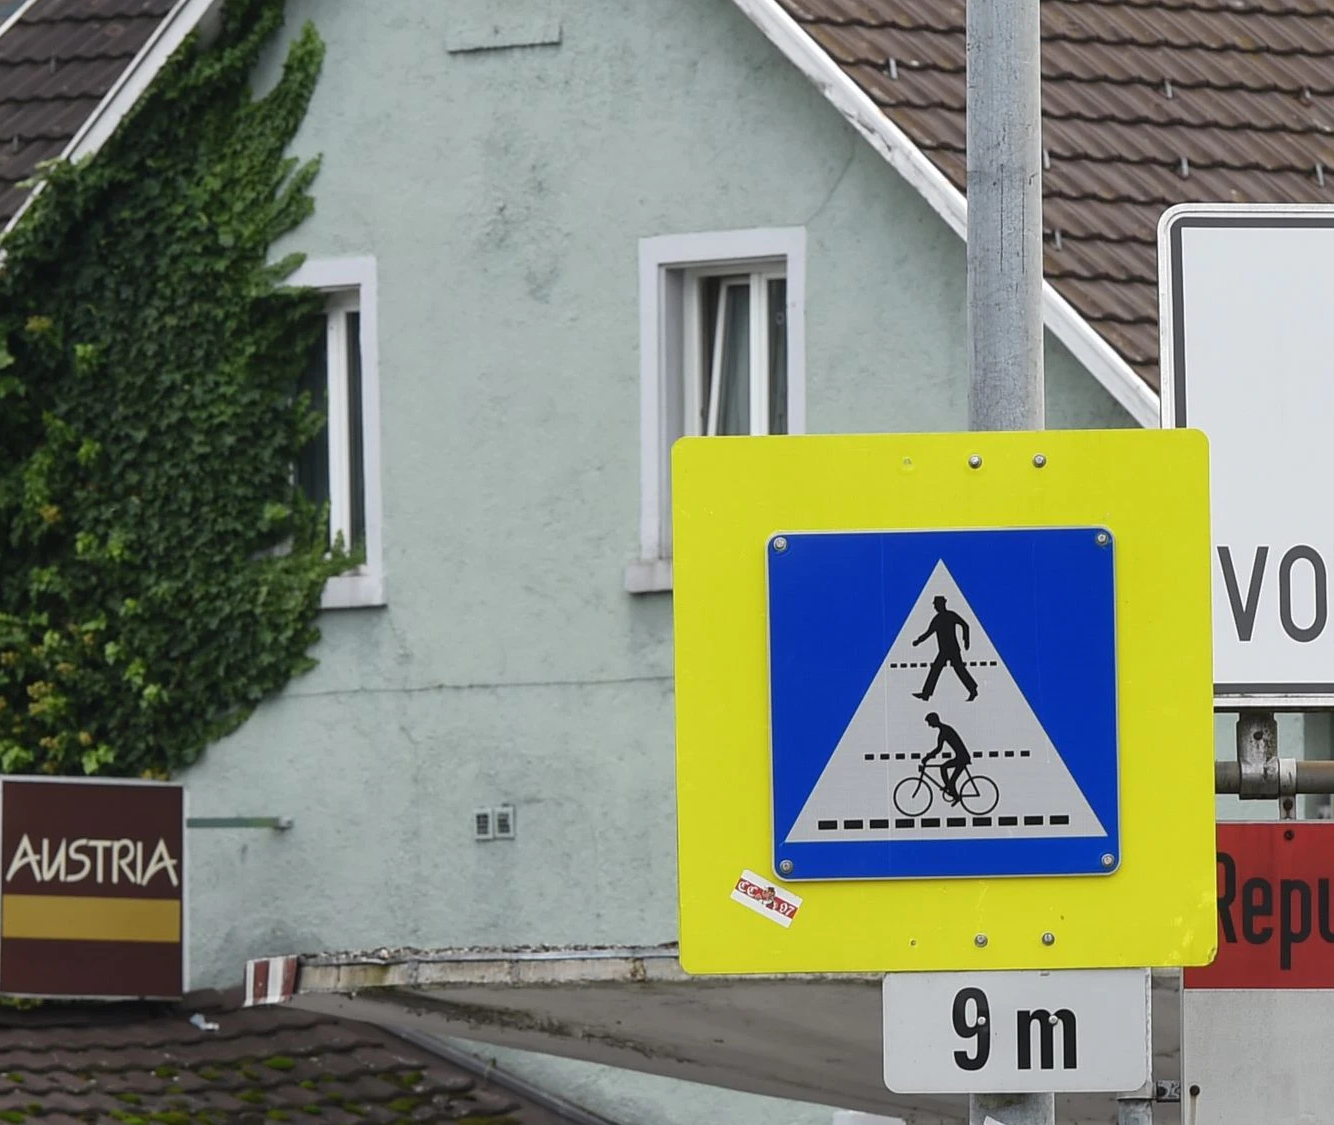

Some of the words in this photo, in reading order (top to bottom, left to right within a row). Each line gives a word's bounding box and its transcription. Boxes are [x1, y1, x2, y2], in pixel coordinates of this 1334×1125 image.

[5, 832, 179, 888] AUSTRIA
[952, 986, 992, 1071] 9
[1016, 1008, 1078, 1070] m
